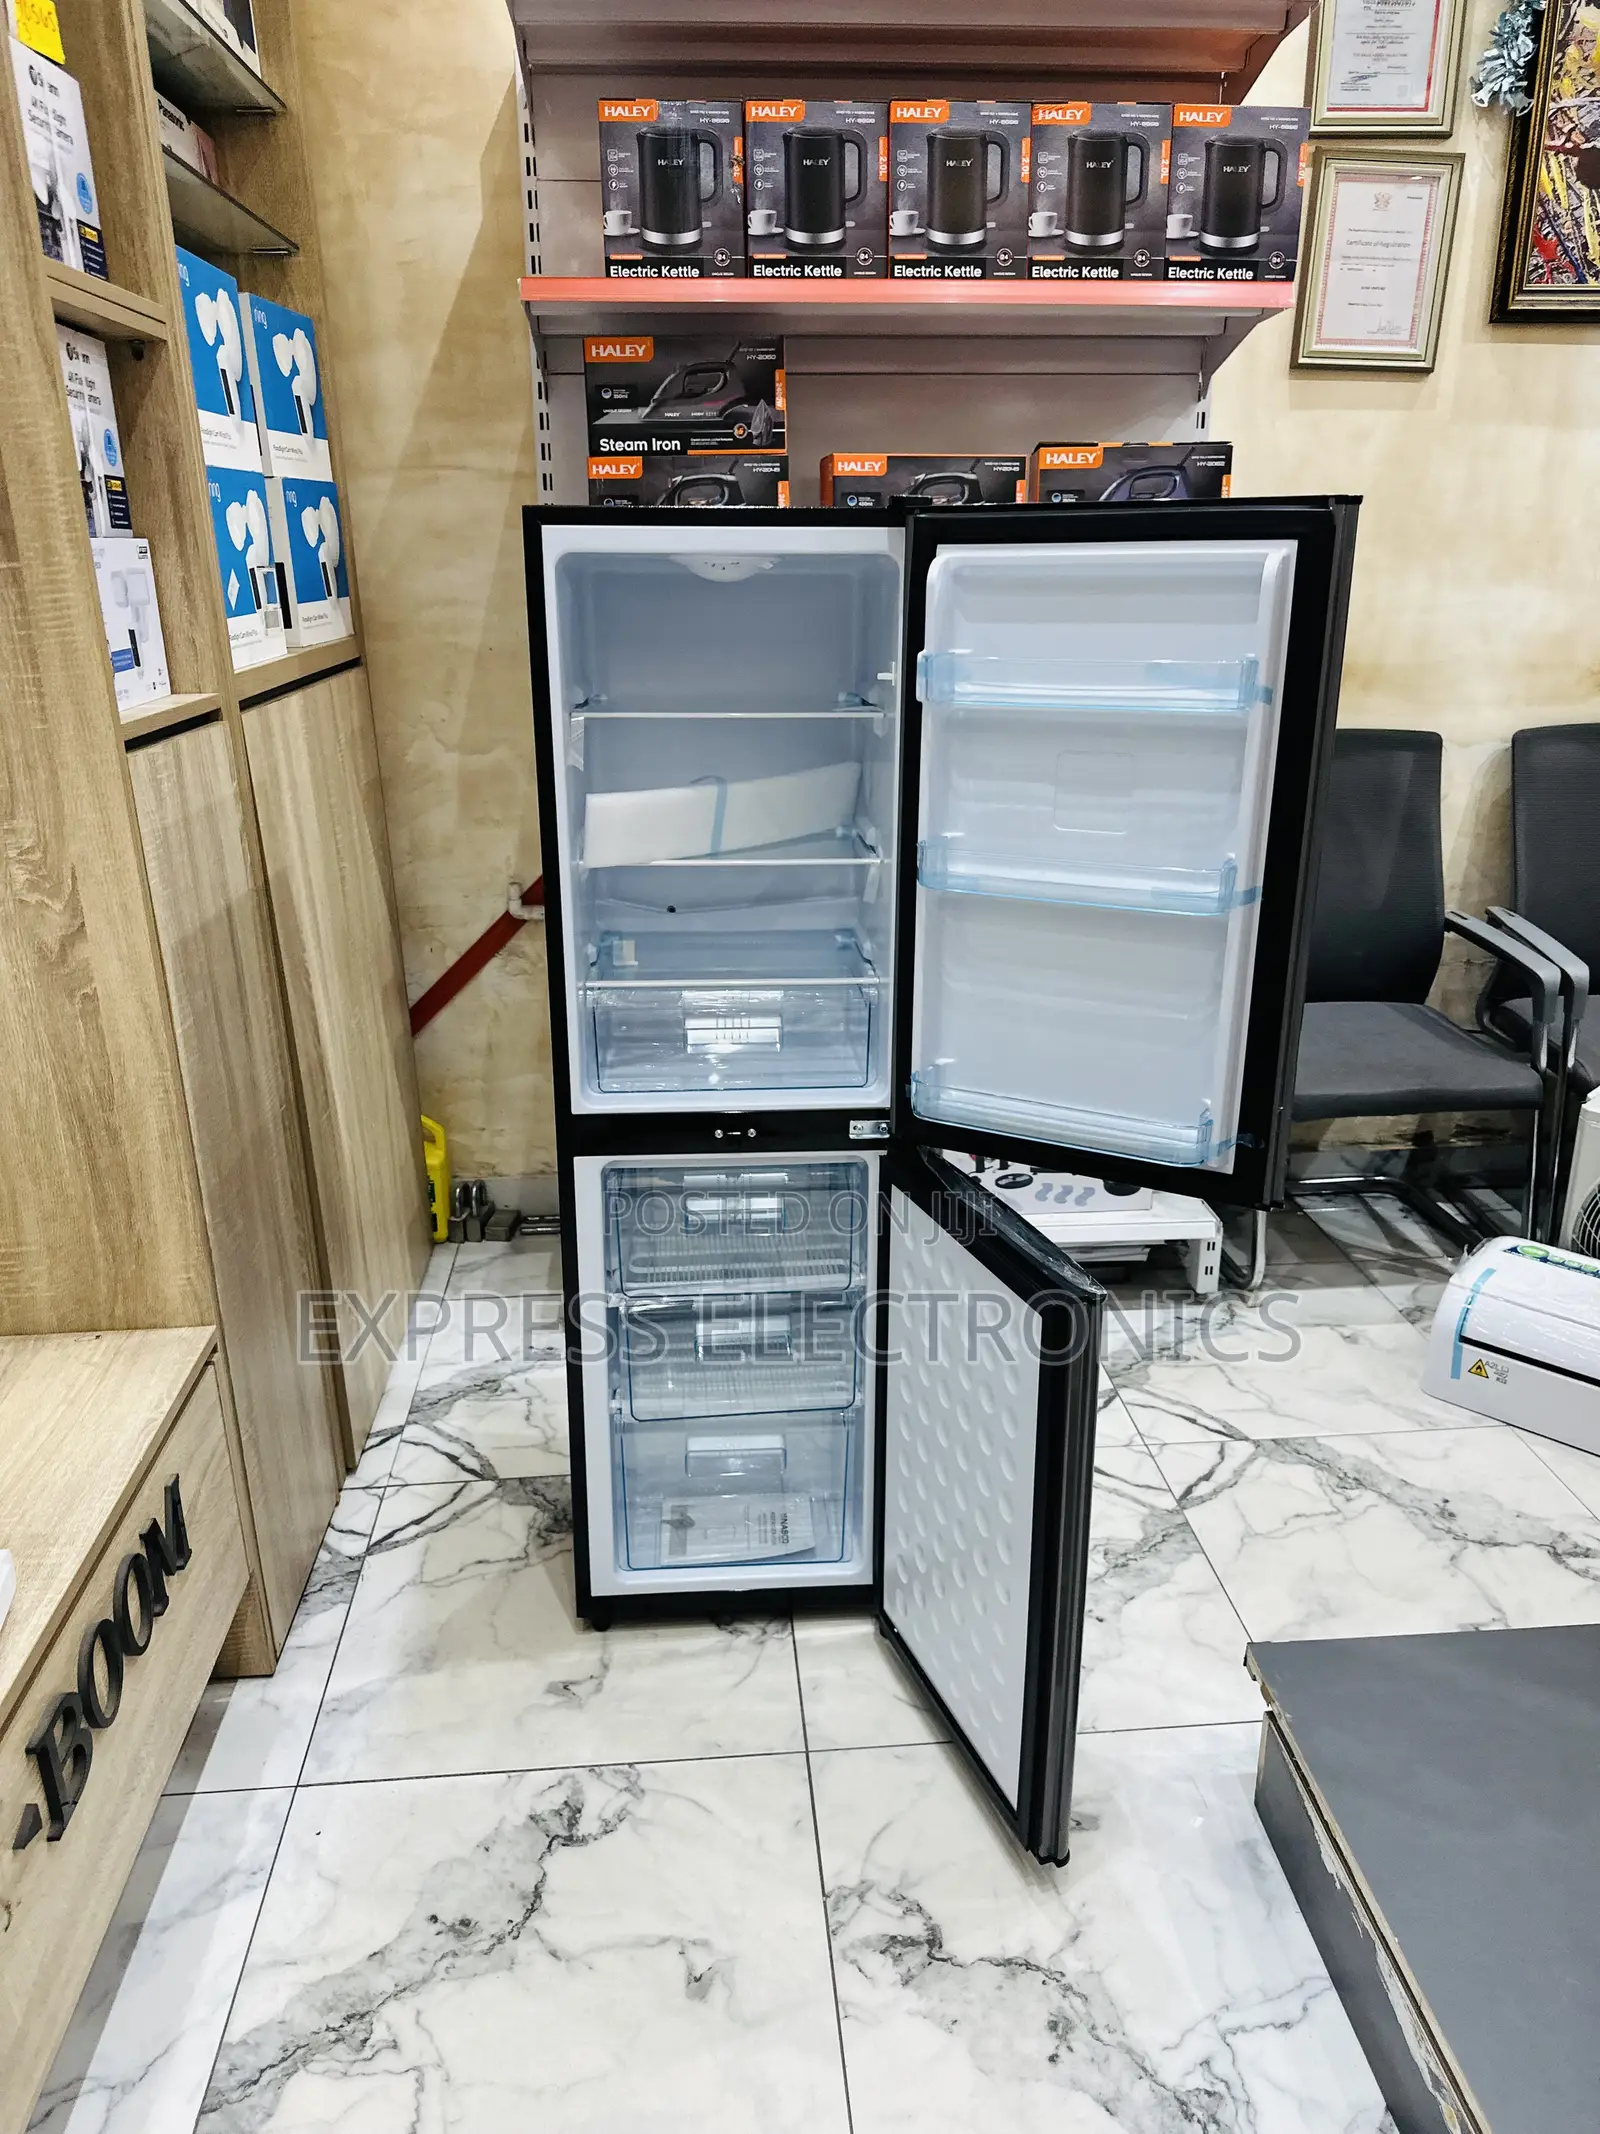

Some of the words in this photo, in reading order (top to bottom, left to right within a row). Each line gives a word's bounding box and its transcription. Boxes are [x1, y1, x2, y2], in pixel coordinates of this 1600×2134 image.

[604, 105, 651, 118] HALEY
[751, 105, 798, 118] HALEY
[896, 106, 942, 118] HALEY
[1038, 108, 1083, 121] HALEY
[1179, 111, 1224, 123] HALEY
[610, 265, 659, 278] Electric
[661, 265, 700, 278] Kettle
[753, 264, 801, 277] Electric
[804, 264, 843, 277] Kettle
[894, 265, 942, 277] Electric
[944, 265, 982, 277] Kettle
[1032, 266, 1079, 278] Electric
[1082, 266, 1119, 279] Kettle
[1168, 267, 1216, 279] Electric
[1217, 268, 1254, 280] Kettle
[591, 344, 647, 357] HALEY
[600, 438, 648, 451] Steam
[652, 437, 681, 451] Iron
[1046, 453, 1097, 465] HALEY
[592, 464, 637, 475] HALEY
[838, 461, 882, 472] HALEY
